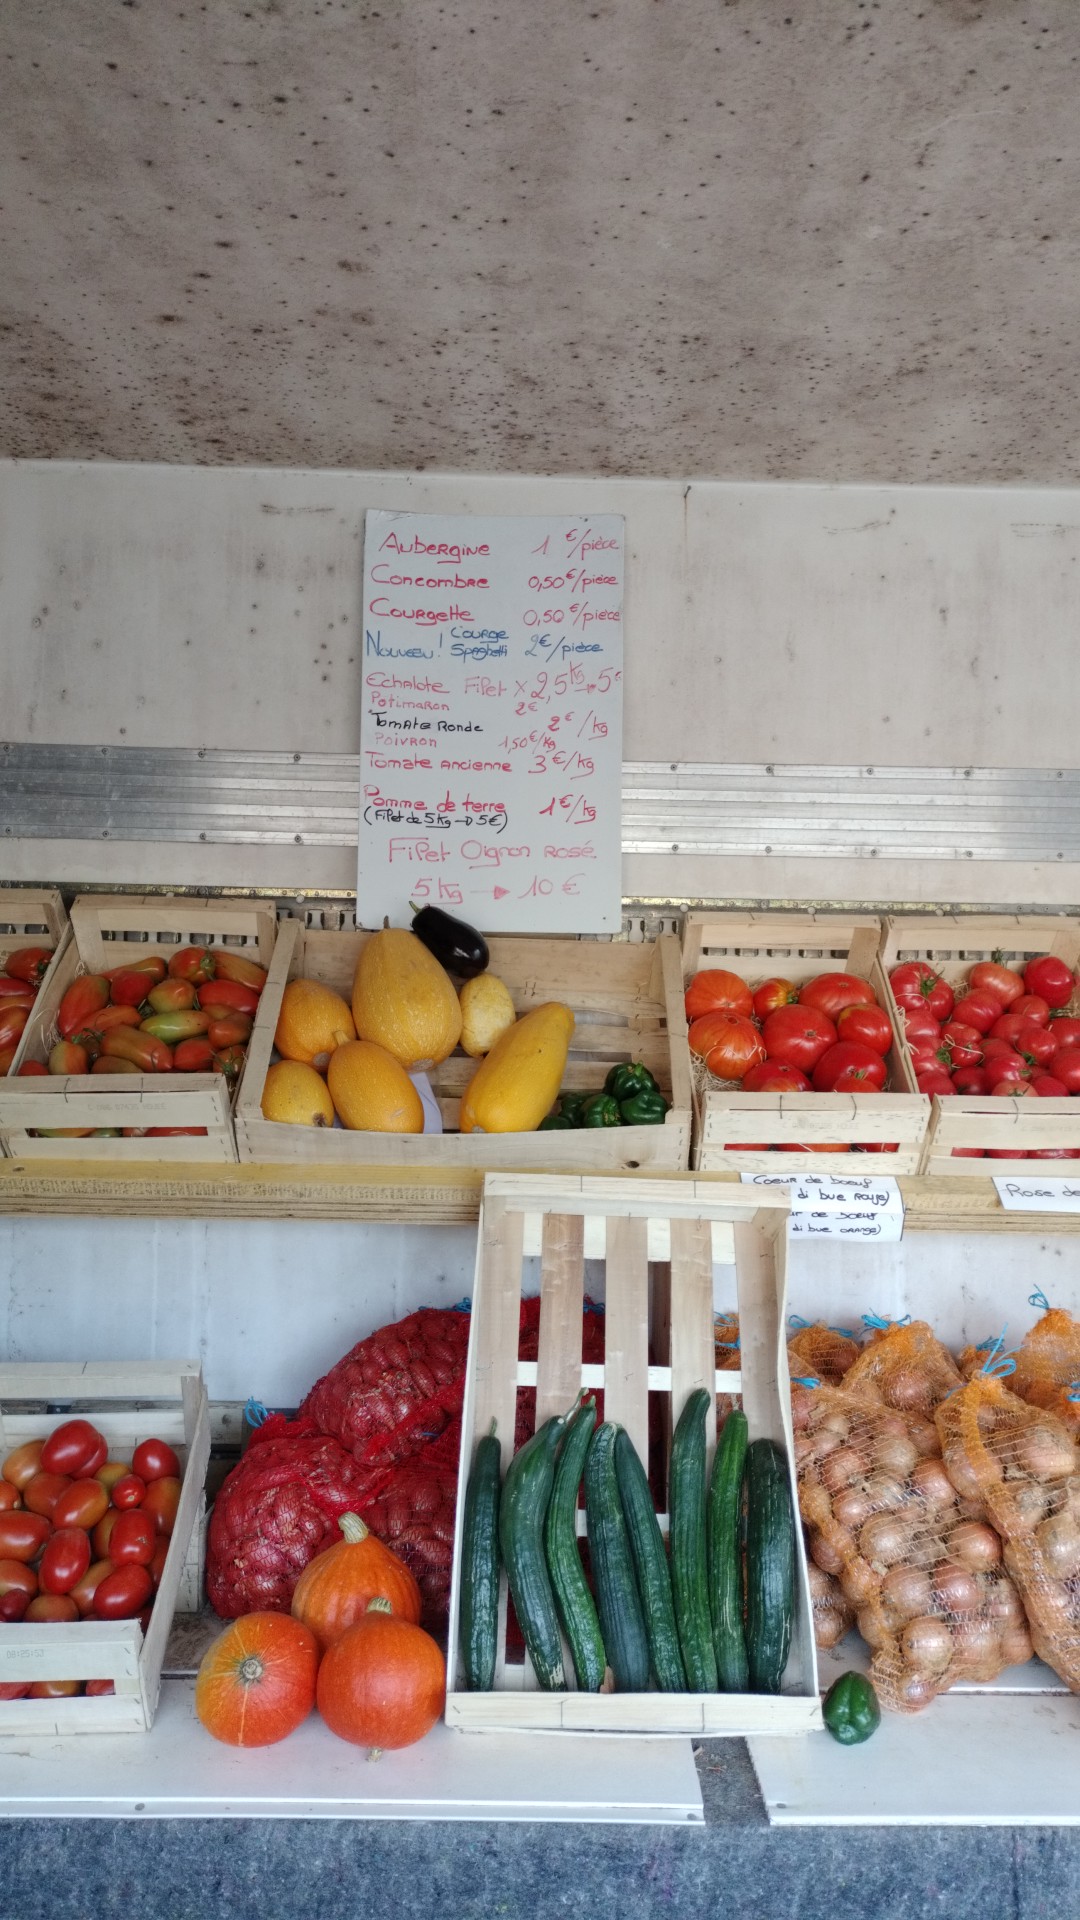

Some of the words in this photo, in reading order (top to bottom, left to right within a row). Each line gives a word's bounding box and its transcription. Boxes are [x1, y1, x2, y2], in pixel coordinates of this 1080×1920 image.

[370, 563, 491, 589] Concombre
[369, 597, 476, 626] Courgette
[364, 750, 433, 769] Tomate
[363, 784, 428, 812] Pomme
[437, 790, 457, 813] de
[462, 793, 506, 814] terre
[388, 837, 451, 863] Filet
[460, 840, 531, 870] Oignon
[804, 1175, 824, 1184] de
[818, 1188, 847, 1201] bue
[1005, 1183, 1055, 1198] Rose
[807, 1223, 832, 1233] bue
